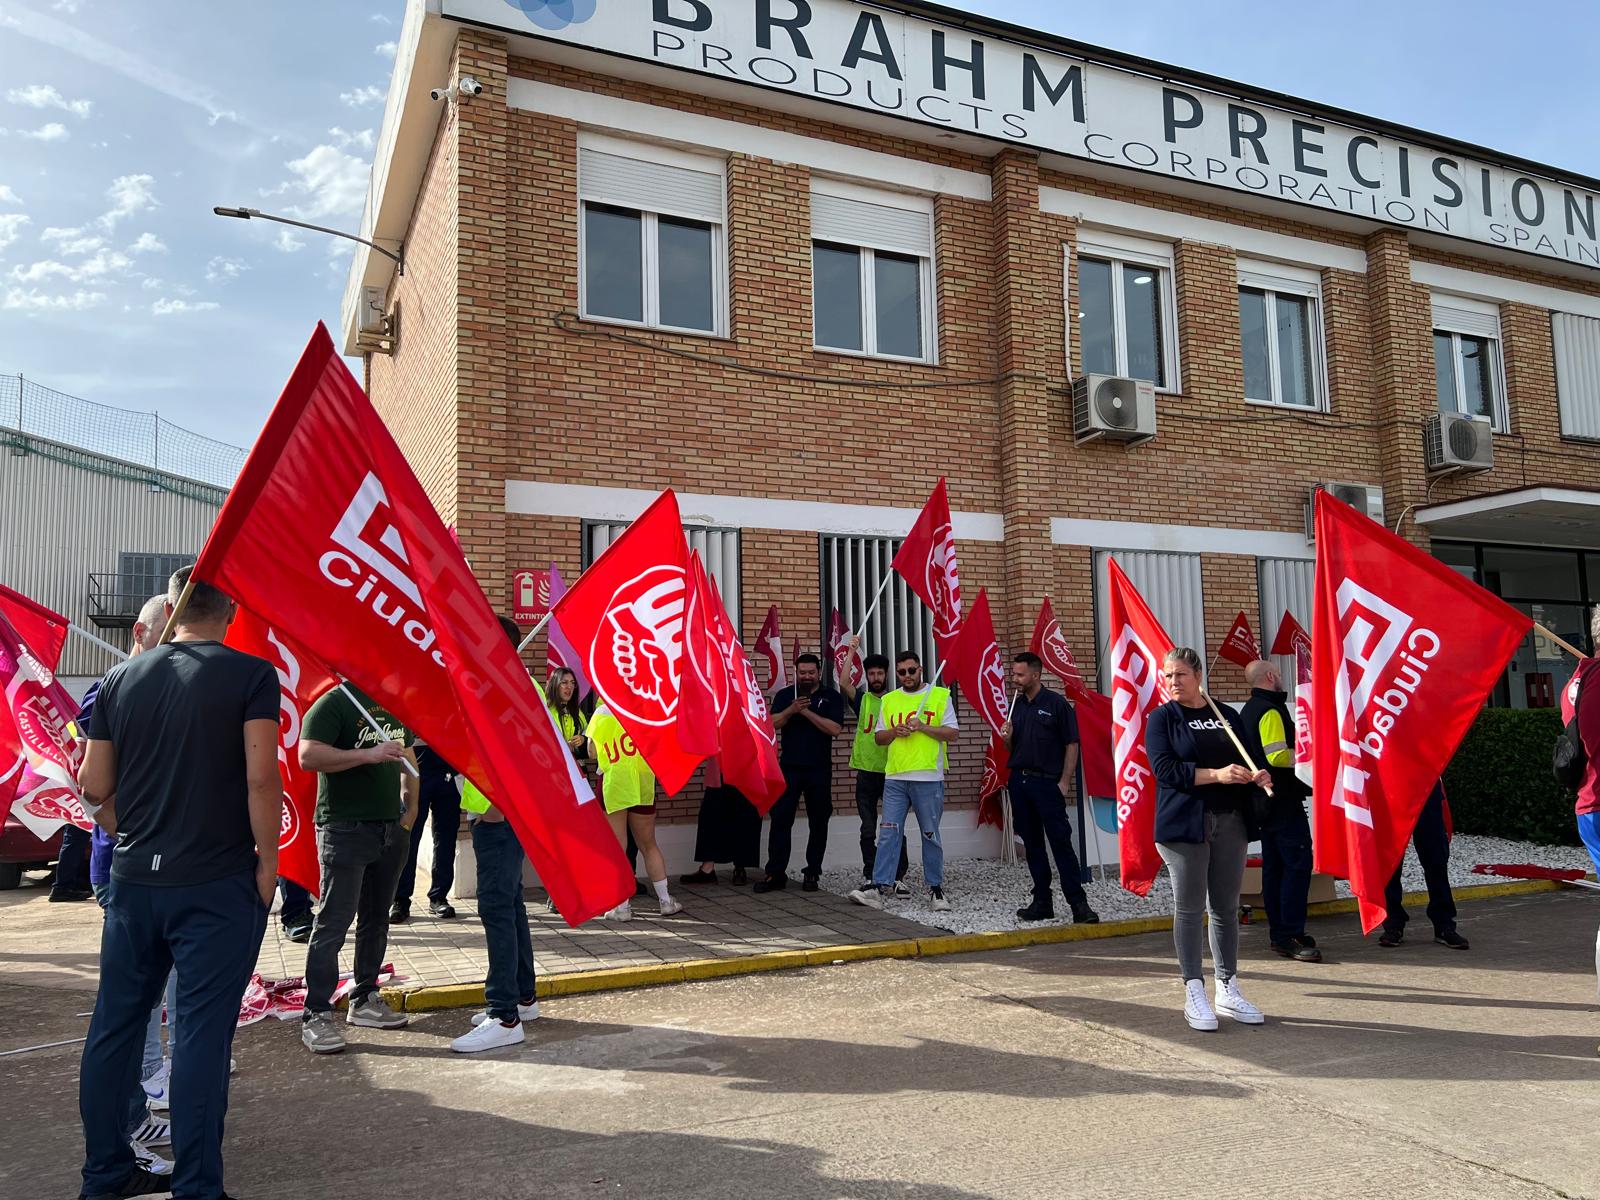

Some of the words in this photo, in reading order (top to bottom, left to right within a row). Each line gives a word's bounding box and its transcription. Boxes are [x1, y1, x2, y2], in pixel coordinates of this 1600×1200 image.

[652, 30, 1028, 138] PRODUCTS
[1084, 133, 1450, 232] CORPORATION
[1489, 223, 1600, 265] SPAIN
[1161, 86, 1597, 242] PRECISION
[515, 612, 546, 620] EXTINTO
[319, 550, 493, 698] Ciudad
[499, 706, 574, 798] Rea
[603, 732, 638, 764] UG
[1188, 718, 1233, 730] dida
